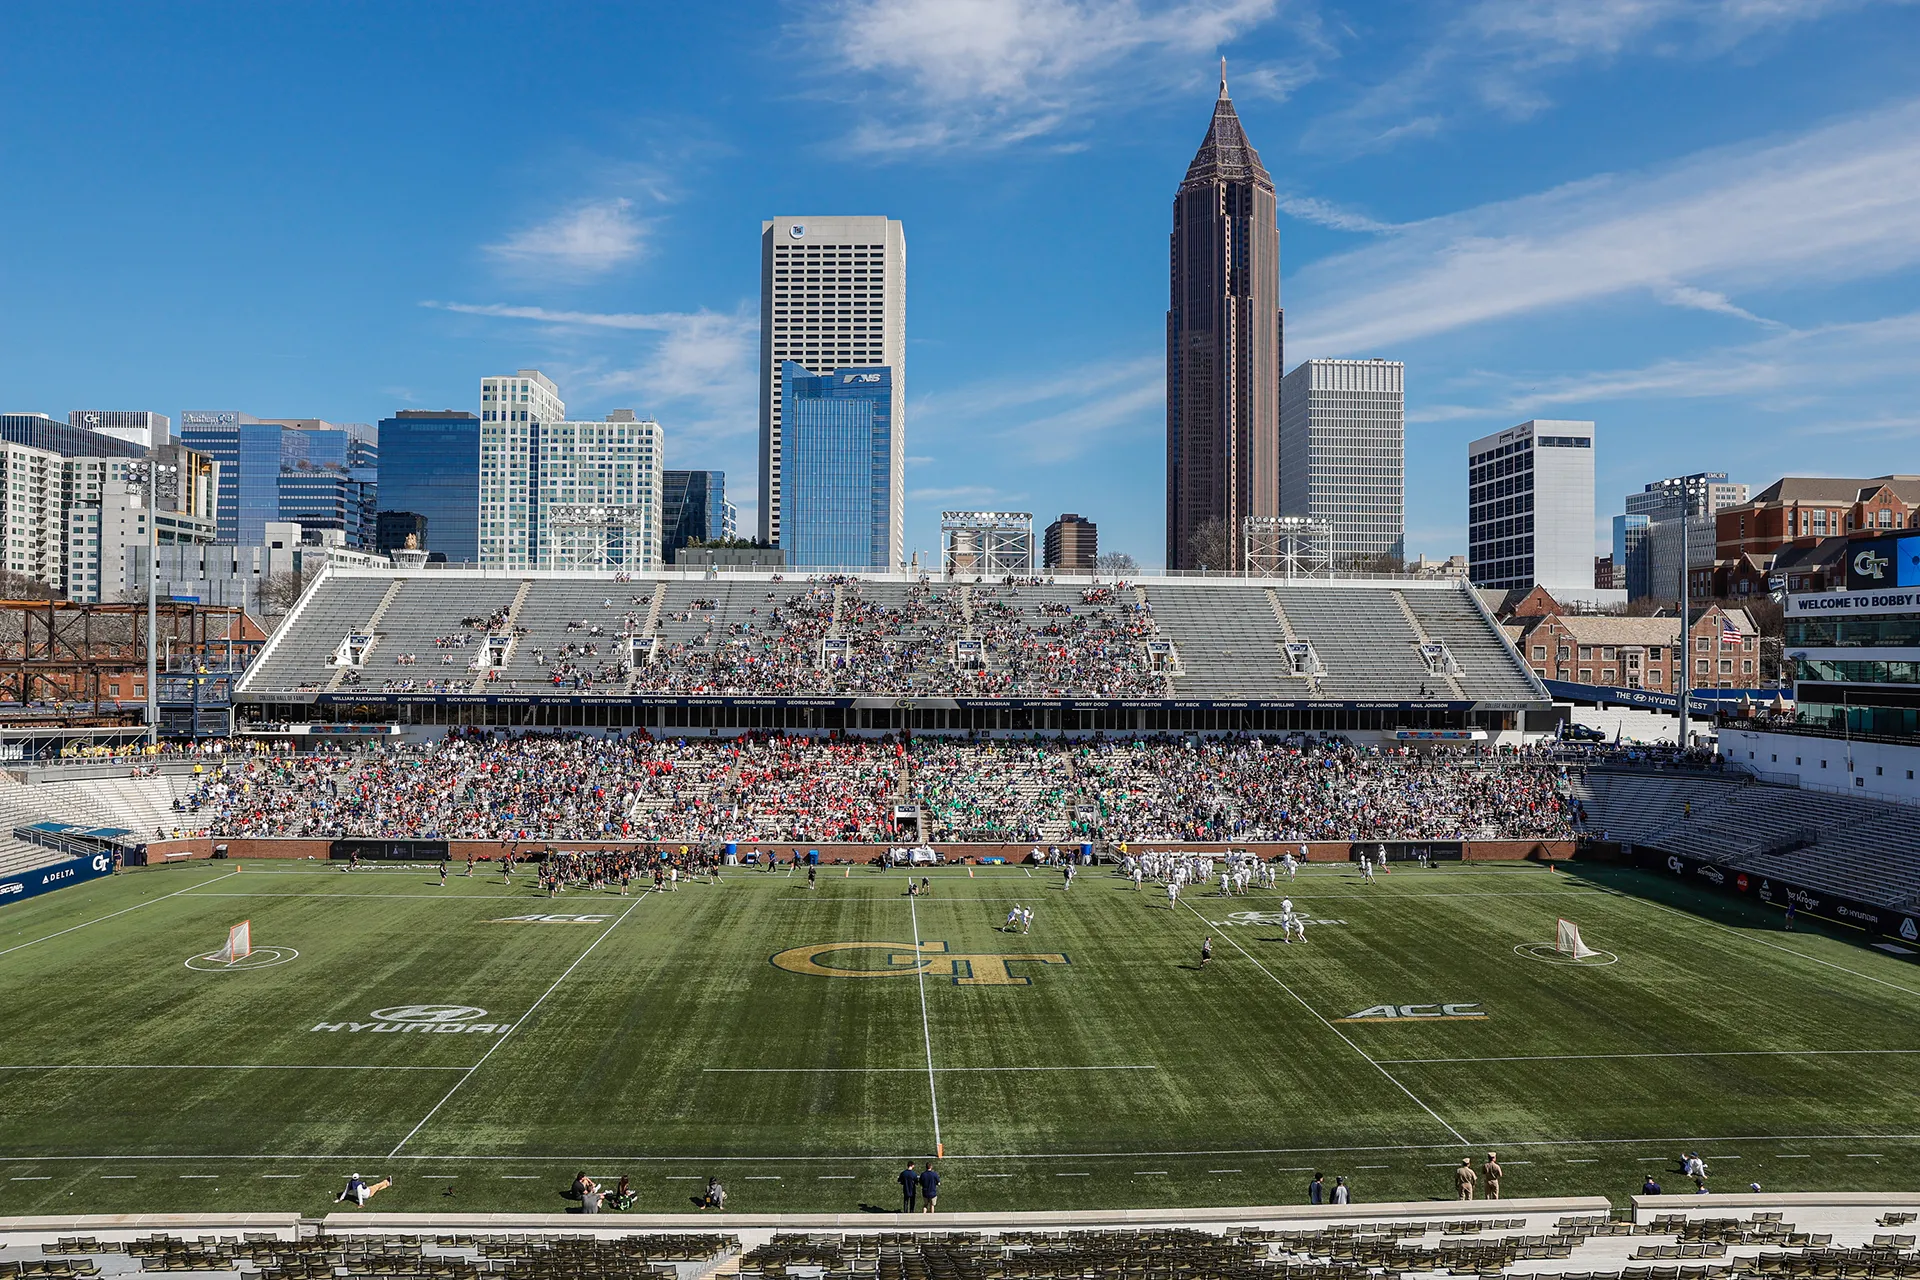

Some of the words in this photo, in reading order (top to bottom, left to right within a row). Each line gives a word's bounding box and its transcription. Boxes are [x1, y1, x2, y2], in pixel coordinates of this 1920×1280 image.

[84, 414, 100, 424] GT
[1853, 550, 1888, 579] GT
[1798, 599, 1851, 610] WELCOME
[1853, 598, 1869, 607] TO
[1871, 594, 1913, 607] BOBBY
[896, 697, 916, 711] GT
[1615, 691, 1631, 700] THE
[1648, 695, 1677, 706] HYUND
[1687, 701, 1708, 710] NEST
[92, 854, 110, 872] GT
[1668, 856, 1684, 874] GT
[50, 868, 75, 882] DELTA
[1796, 890, 1820, 910] Kroger
[490, 914, 615, 923] ACC
[1848, 910, 1879, 923] HYUNDAI
[769, 941, 1072, 986] GT
[1344, 1003, 1488, 1018] ACC
[310, 1022, 511, 1033] HYUNDAI
